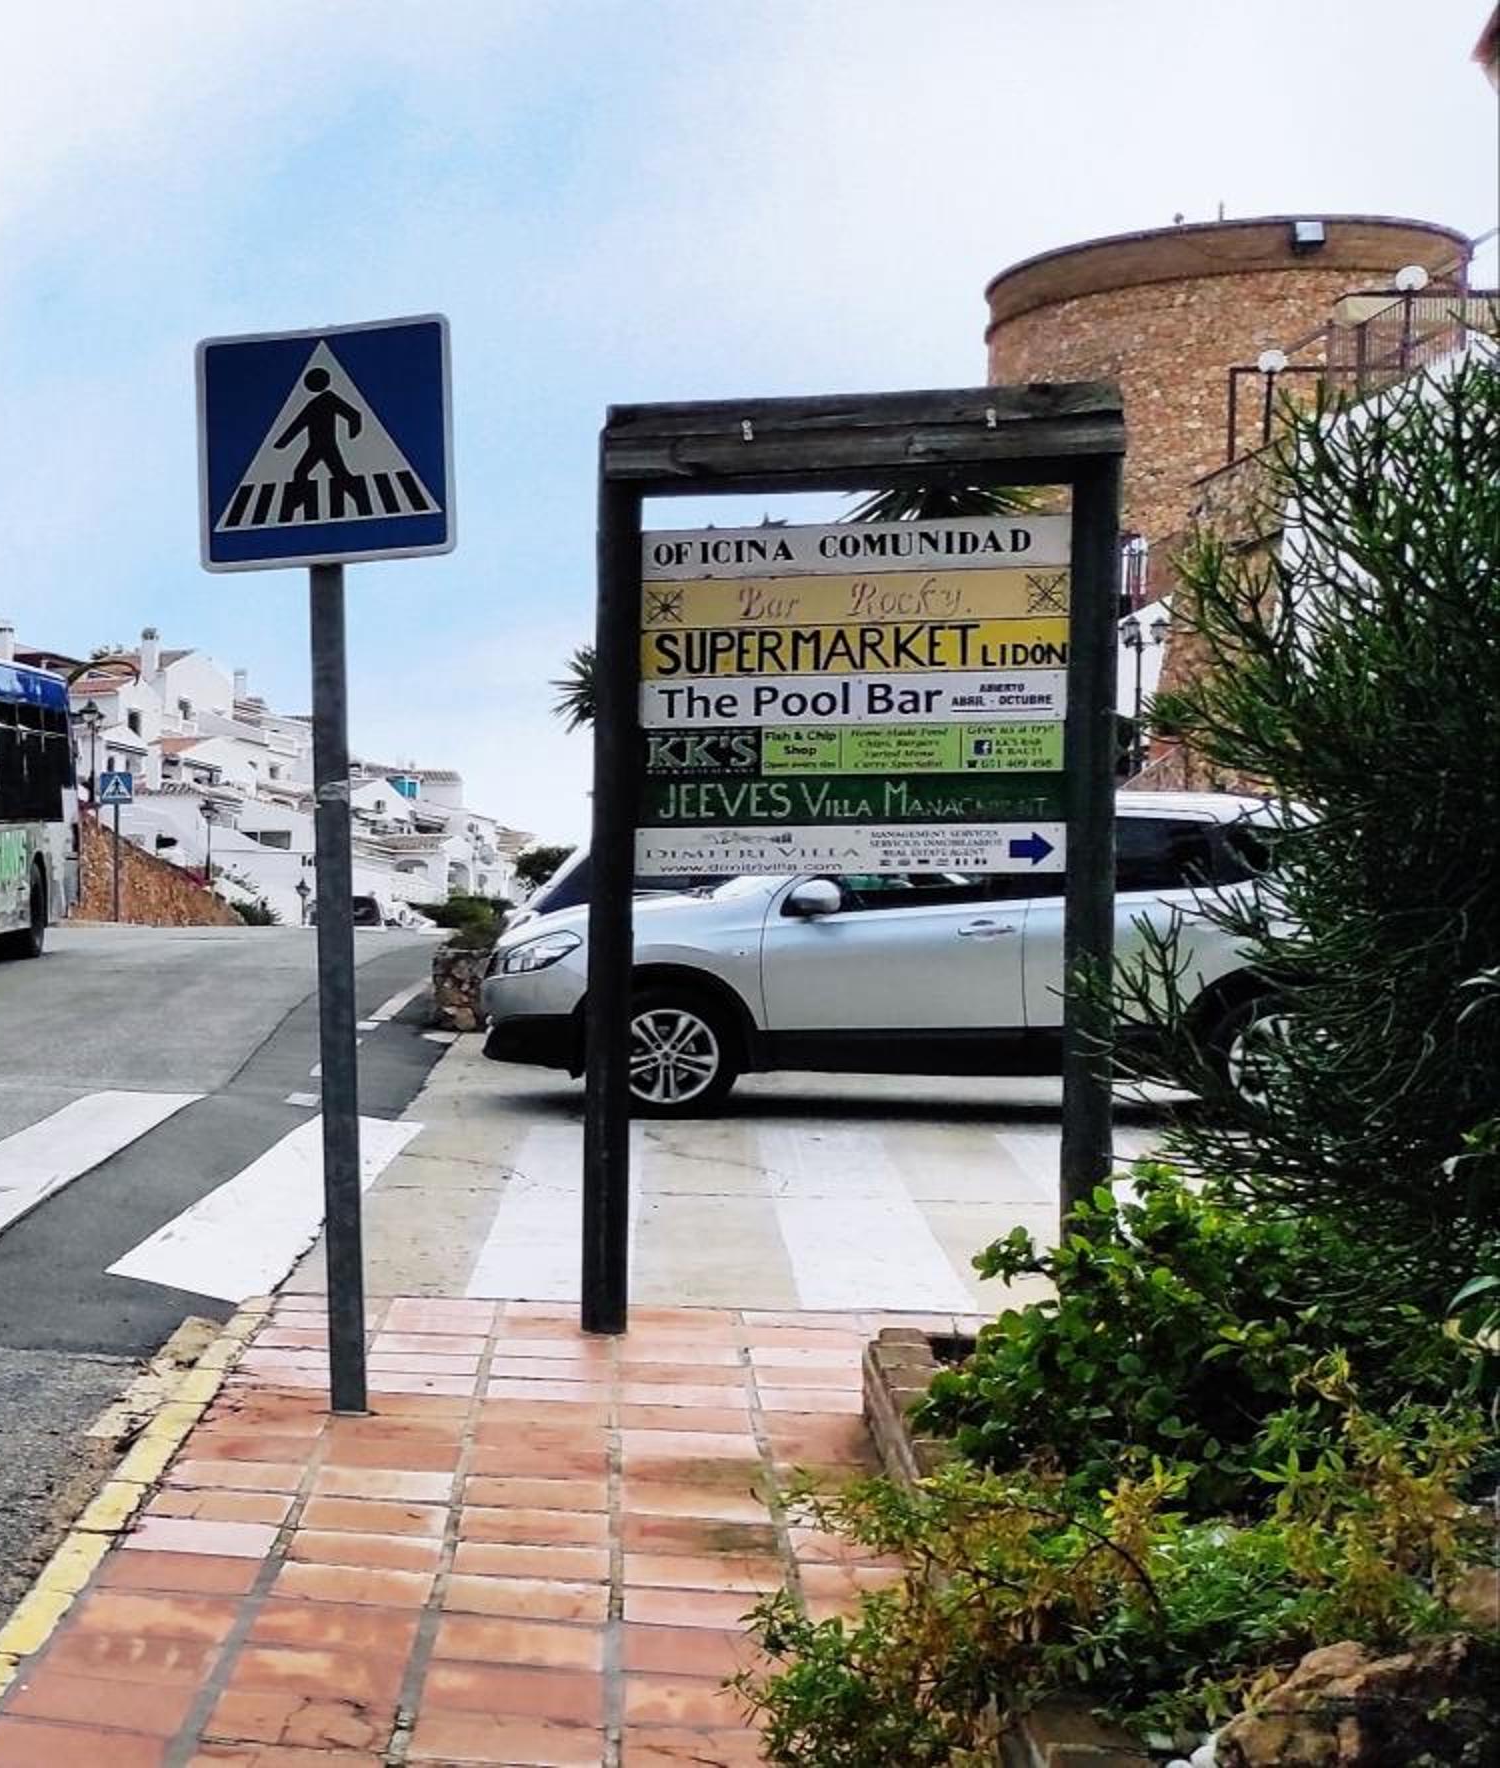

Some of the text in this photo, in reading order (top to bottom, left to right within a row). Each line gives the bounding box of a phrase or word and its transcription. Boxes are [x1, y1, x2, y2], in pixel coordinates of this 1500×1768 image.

[654, 529, 1031, 566] OFICINA COMUNIDAD
[739, 585, 799, 620] Bar
[655, 624, 980, 675] SUPERMARKET
[658, 682, 943, 718] The Pool Bar
[952, 695, 985, 706] ABRIL
[999, 694, 1053, 705] OCTUBRE
[980, 683, 1025, 693] ABIERTO
[646, 735, 758, 768] KK'S
[784, 745, 817, 756] Shop
[659, 782, 792, 819] JEEVES
